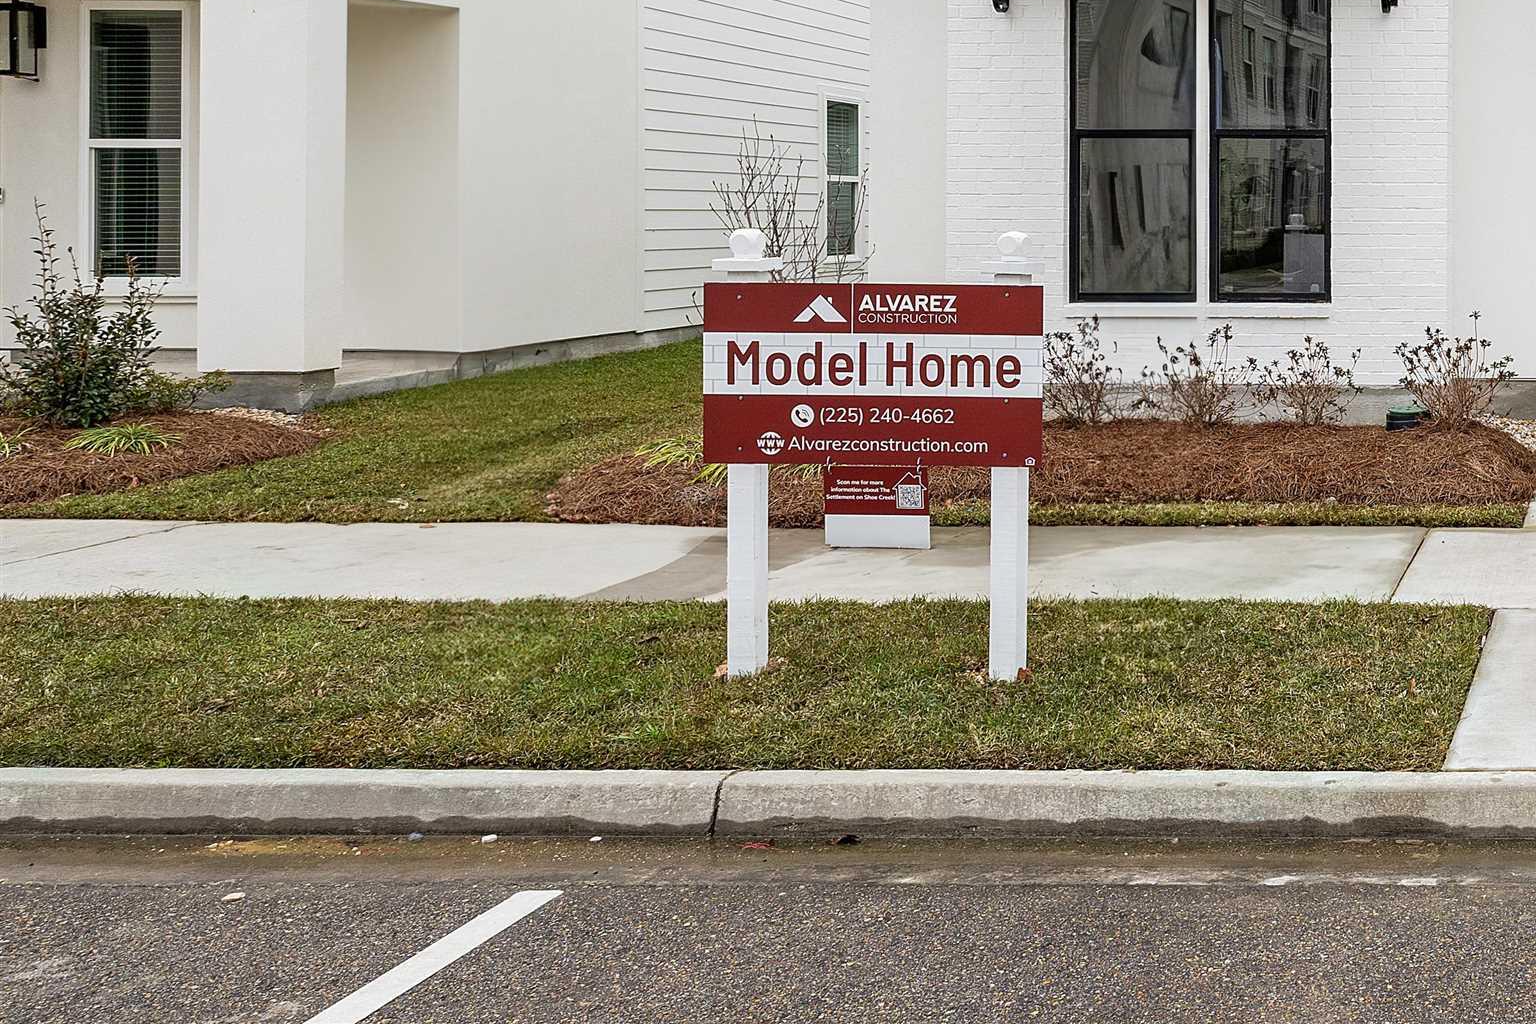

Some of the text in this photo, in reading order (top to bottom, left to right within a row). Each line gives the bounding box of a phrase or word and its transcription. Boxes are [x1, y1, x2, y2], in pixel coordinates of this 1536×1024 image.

[858, 294, 957, 313] ALVAREZ
[858, 313, 957, 324] CONSTRUCTION
[726, 340, 1022, 389] Model Home
[819, 407, 955, 425] (225) 240-4662
[787, 436, 989, 453] Alvarezconstruction.com
